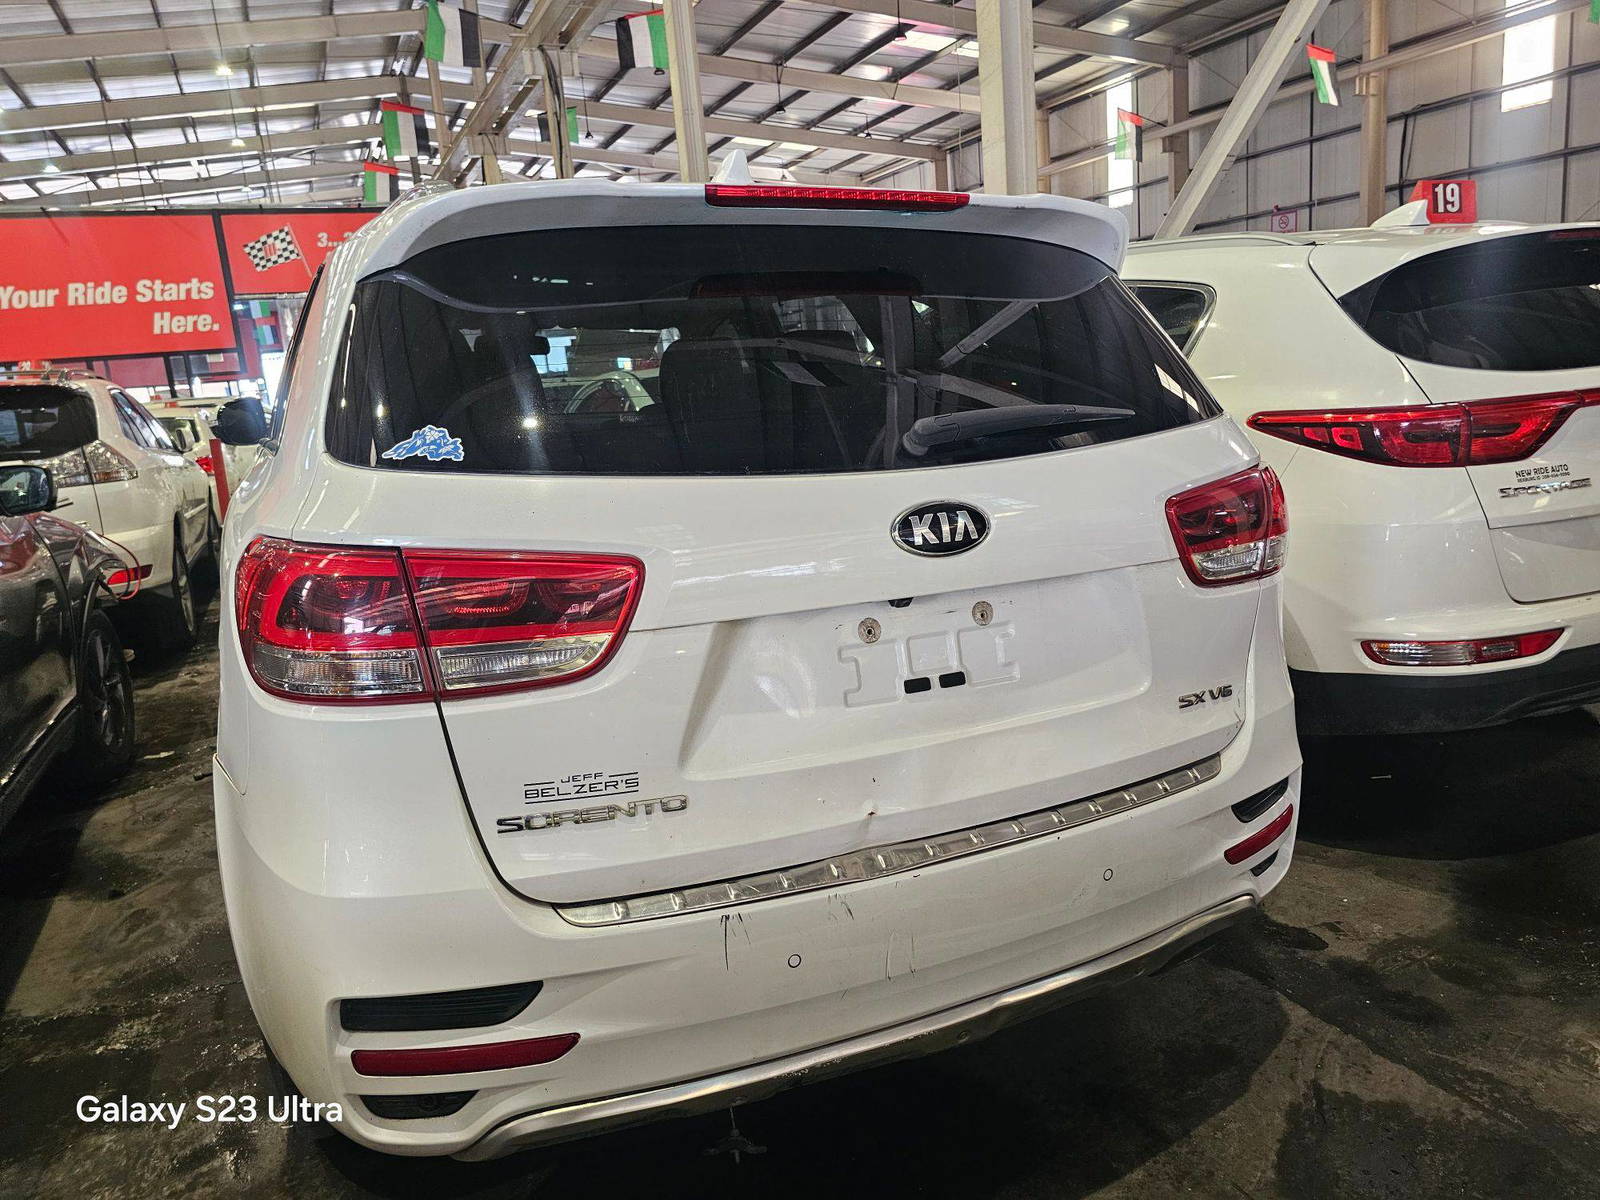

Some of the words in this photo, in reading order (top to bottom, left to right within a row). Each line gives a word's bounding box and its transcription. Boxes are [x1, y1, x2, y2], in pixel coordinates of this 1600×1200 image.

[1434, 183, 1461, 213] 19
[0, 286, 60, 309] Your
[67, 281, 128, 306] Ride
[135, 278, 214, 303] Starts
[153, 312, 220, 335] Here.
[1515, 469, 1532, 478] NEW
[1533, 466, 1549, 475] RIDE
[1551, 464, 1569, 473] AUTO
[1499, 477, 1592, 498] SPORTAGE
[909, 510, 979, 546] KIA
[1178, 690, 1206, 709] SX
[1208, 684, 1233, 700] V6
[524, 778, 640, 799] BELZER'S
[560, 772, 604, 784] JEFF
[496, 795, 689, 834] SORENTO
